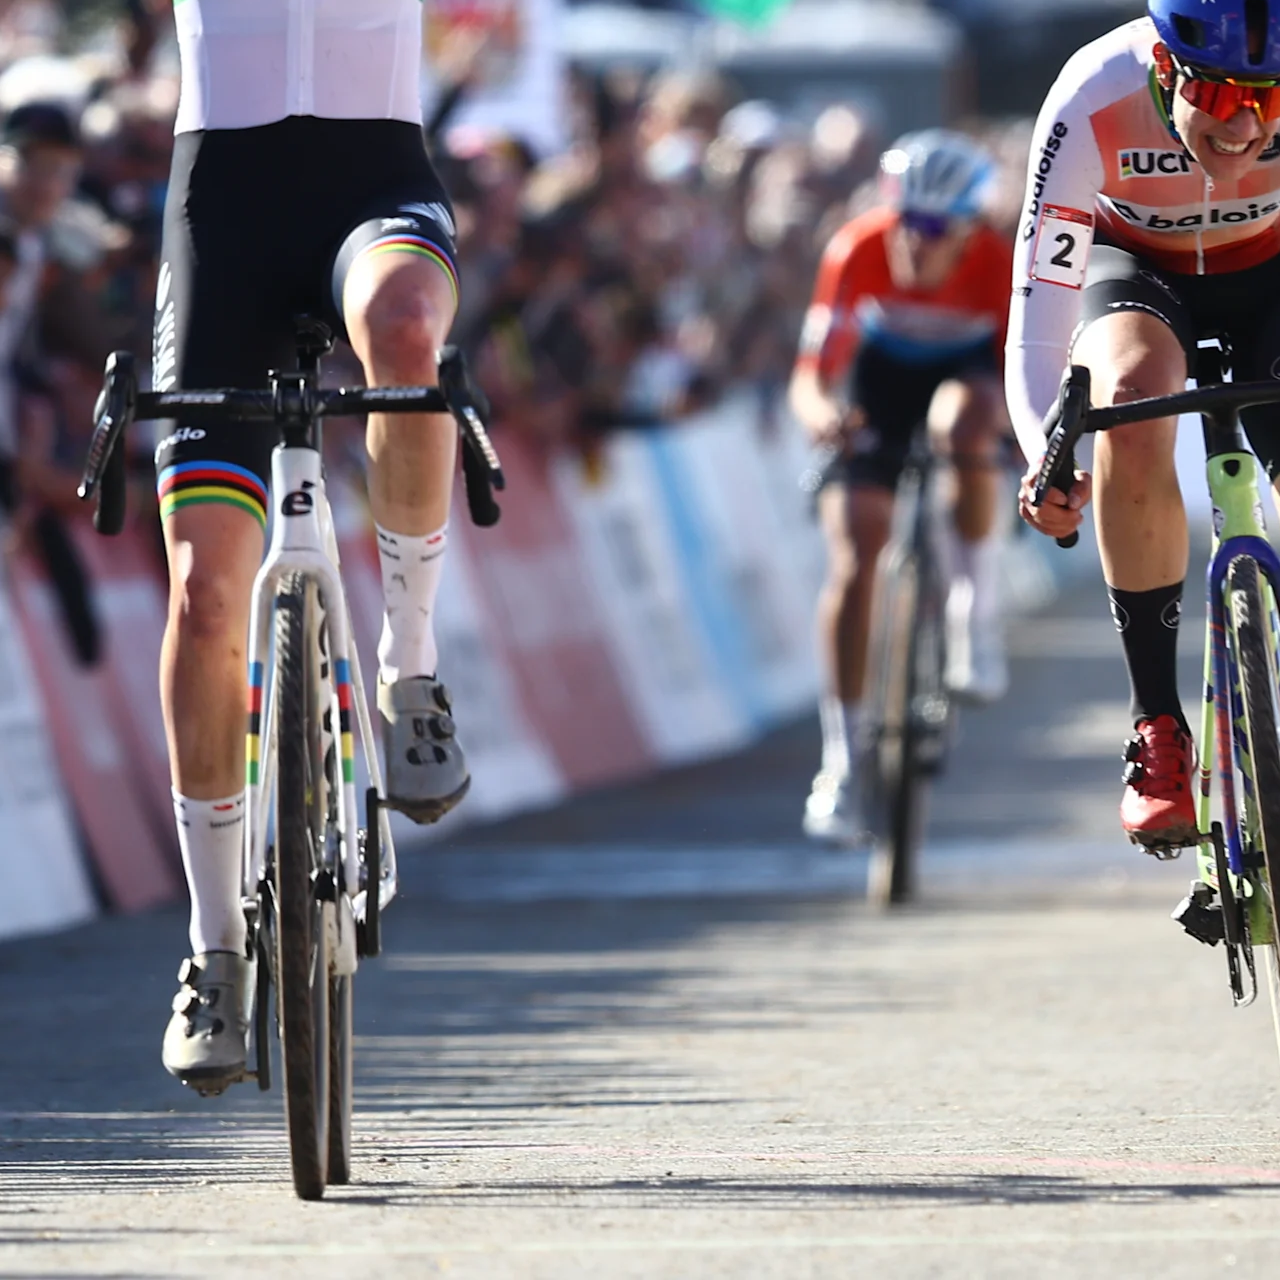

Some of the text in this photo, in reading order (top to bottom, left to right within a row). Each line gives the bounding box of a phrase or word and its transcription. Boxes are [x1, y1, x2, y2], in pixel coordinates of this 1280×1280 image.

[1028, 121, 1068, 216] baloise
[1132, 151, 1192, 174] UCI
[1050, 232, 1076, 269] 2
